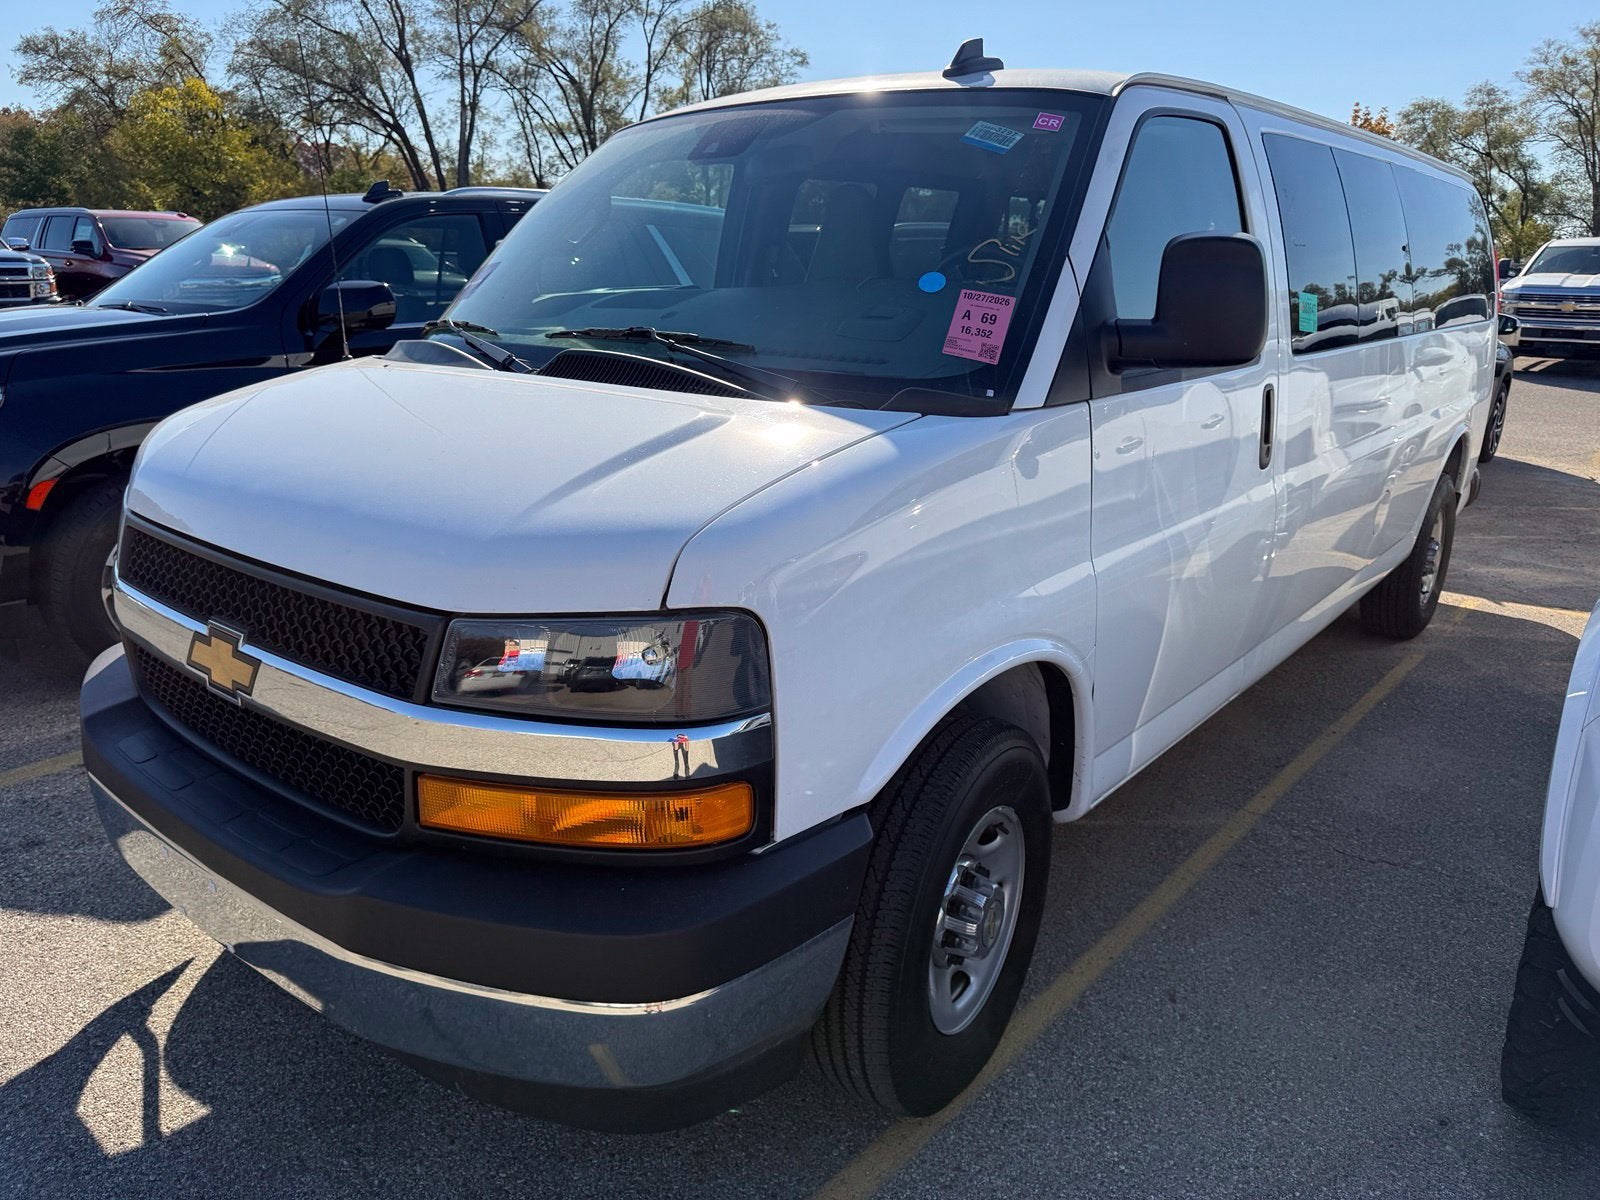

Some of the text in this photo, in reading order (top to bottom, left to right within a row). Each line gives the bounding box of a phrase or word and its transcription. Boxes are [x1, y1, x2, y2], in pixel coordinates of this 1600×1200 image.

[1038, 117, 1059, 127] CR
[962, 309, 998, 325] A 69
